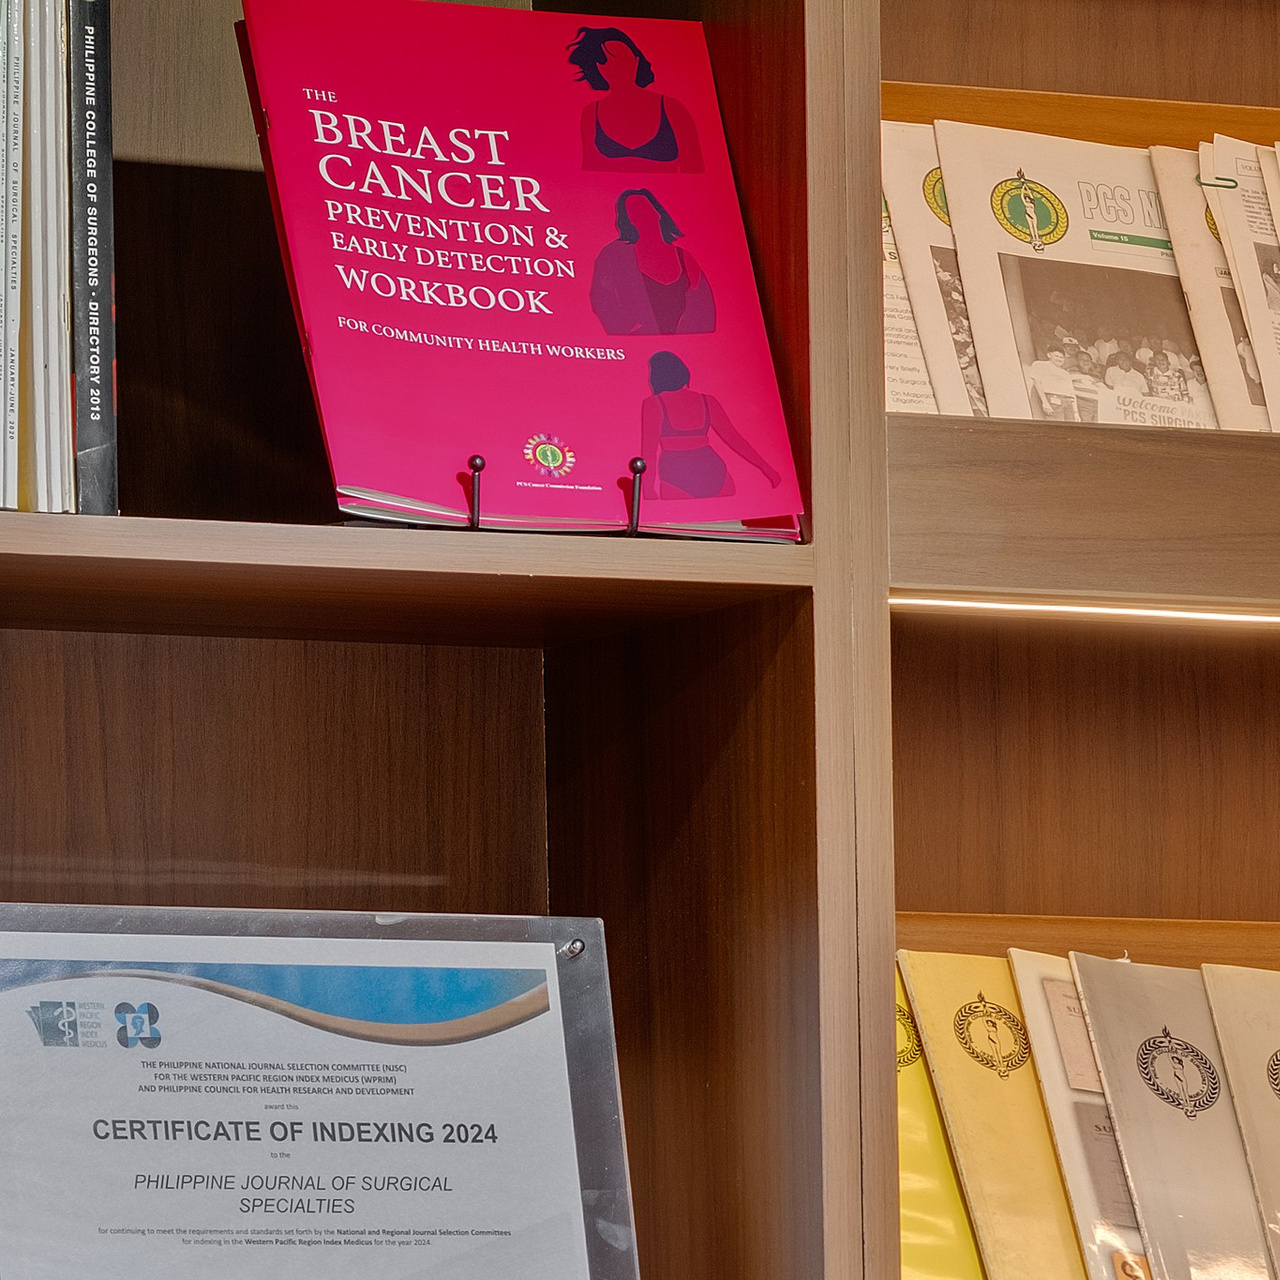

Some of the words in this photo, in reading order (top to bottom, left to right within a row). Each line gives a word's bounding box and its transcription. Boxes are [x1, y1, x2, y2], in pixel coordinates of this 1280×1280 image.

[84, 25, 96, 106] PHILIPPINE
[303, 88, 338, 102] THE
[85, 110, 97, 178] COLLEGE
[309, 109, 509, 166] BREAST
[13, 162, 19, 173] OF
[318, 154, 550, 213] CANCER
[87, 182, 97, 203] OF
[1077, 181, 1134, 225] PCS
[87, 206, 99, 287] SURGEONS
[324, 199, 534, 248] PREVENTION
[545, 227, 569, 250] &
[10, 234, 18, 290] SPECIALTIES
[330, 231, 408, 263] EARLY
[415, 248, 576, 279] DETECTION
[334, 264, 553, 315] WORKBOOK
[88, 301, 100, 384] DIRECTORY
[337, 316, 369, 334] FOR
[371, 324, 474, 351] COMMUNITY
[478, 339, 542, 356] HEALTH
[545, 344, 625, 361] WORKERS
[8, 348, 16, 417] JANUARY-JUNE,
[89, 389, 101, 421] 2013
[141, 1060, 157, 1069] THE
[159, 1061, 202, 1069] PHILIPPINE
[205, 1062, 246, 1070] NATIONAL
[248, 1062, 285, 1071] JOURNAL
[287, 1063, 329, 1071] SELECTION
[331, 1063, 380, 1071] COMMITTEE
[382, 1064, 407, 1073] (NJSC)
[154, 1073, 170, 1081] FOR
[172, 1073, 188, 1081] THE
[190, 1074, 229, 1082] WESTERN
[231, 1074, 261, 1082] PACIFIC
[262, 1074, 294, 1082] REGION
[296, 1075, 321, 1083] INDEX
[322, 1075, 359, 1083] MEDICUS
[361, 1076, 397, 1085] (WPRIM)
[92, 1119, 262, 1141] CERTIFICATE
[269, 1121, 303, 1142] OF
[312, 1122, 435, 1143] INDEXING
[442, 1123, 498, 1144] 2024
[134, 1174, 236, 1190] PHILIPPINE
[241, 1175, 326, 1191] JOURNAL
[332, 1176, 356, 1191] OF
[361, 1176, 453, 1192] SURGICAL
[239, 1198, 355, 1214] SPECIALTIES
